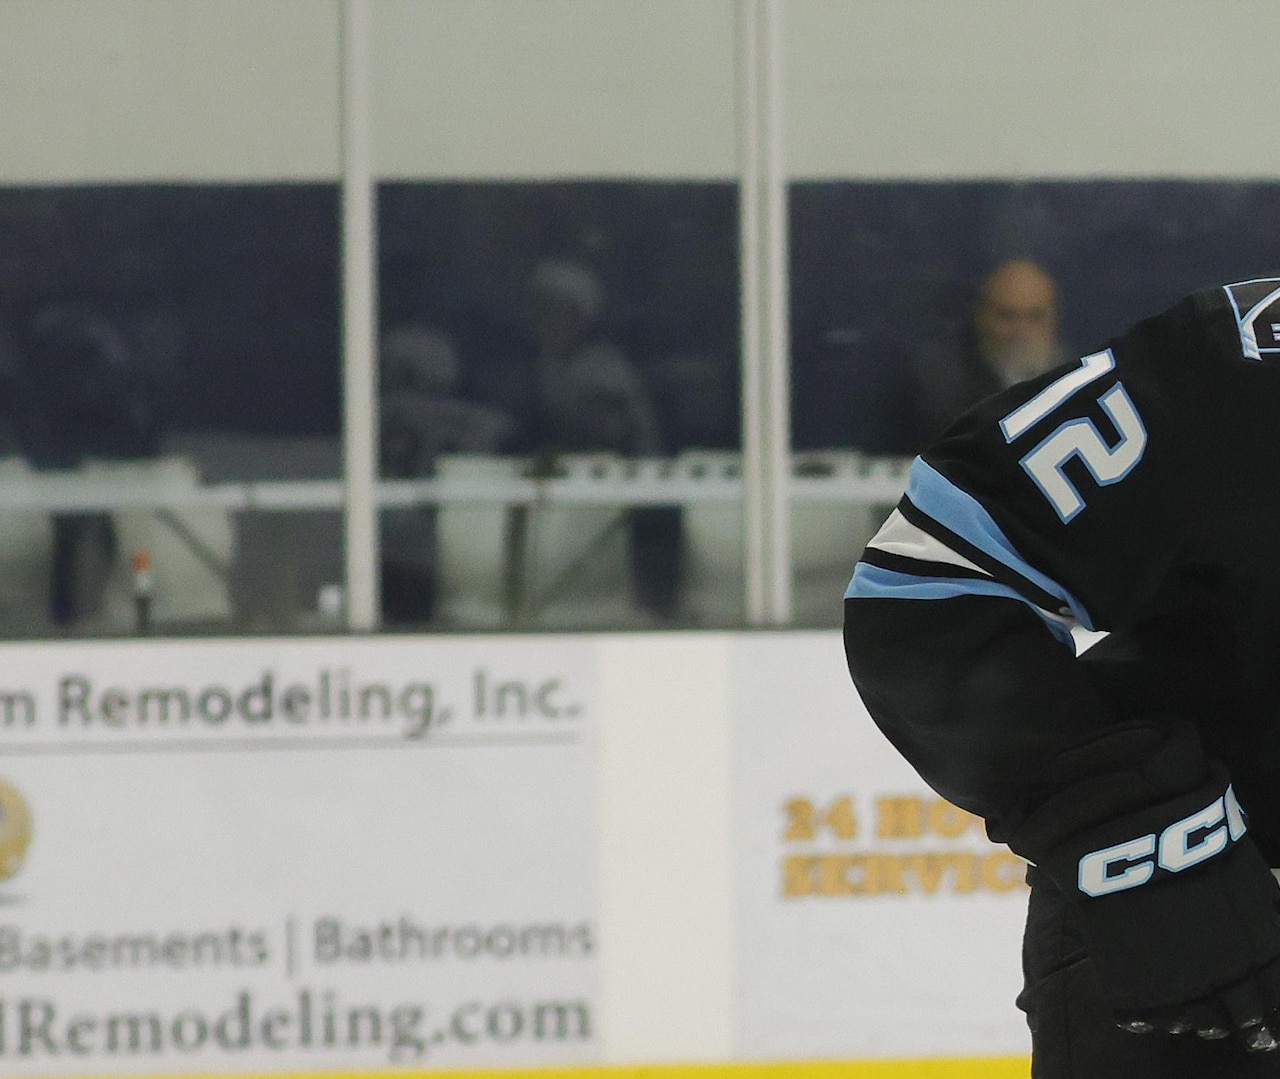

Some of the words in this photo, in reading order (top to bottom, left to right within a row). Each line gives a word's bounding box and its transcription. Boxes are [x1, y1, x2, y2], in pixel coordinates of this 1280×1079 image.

[999, 348, 1147, 525] 12
[58, 668, 453, 740] Remodeling,
[473, 667, 582, 719] Inc.
[0, 925, 268, 970] Basements
[314, 914, 595, 963] Bathrooms
